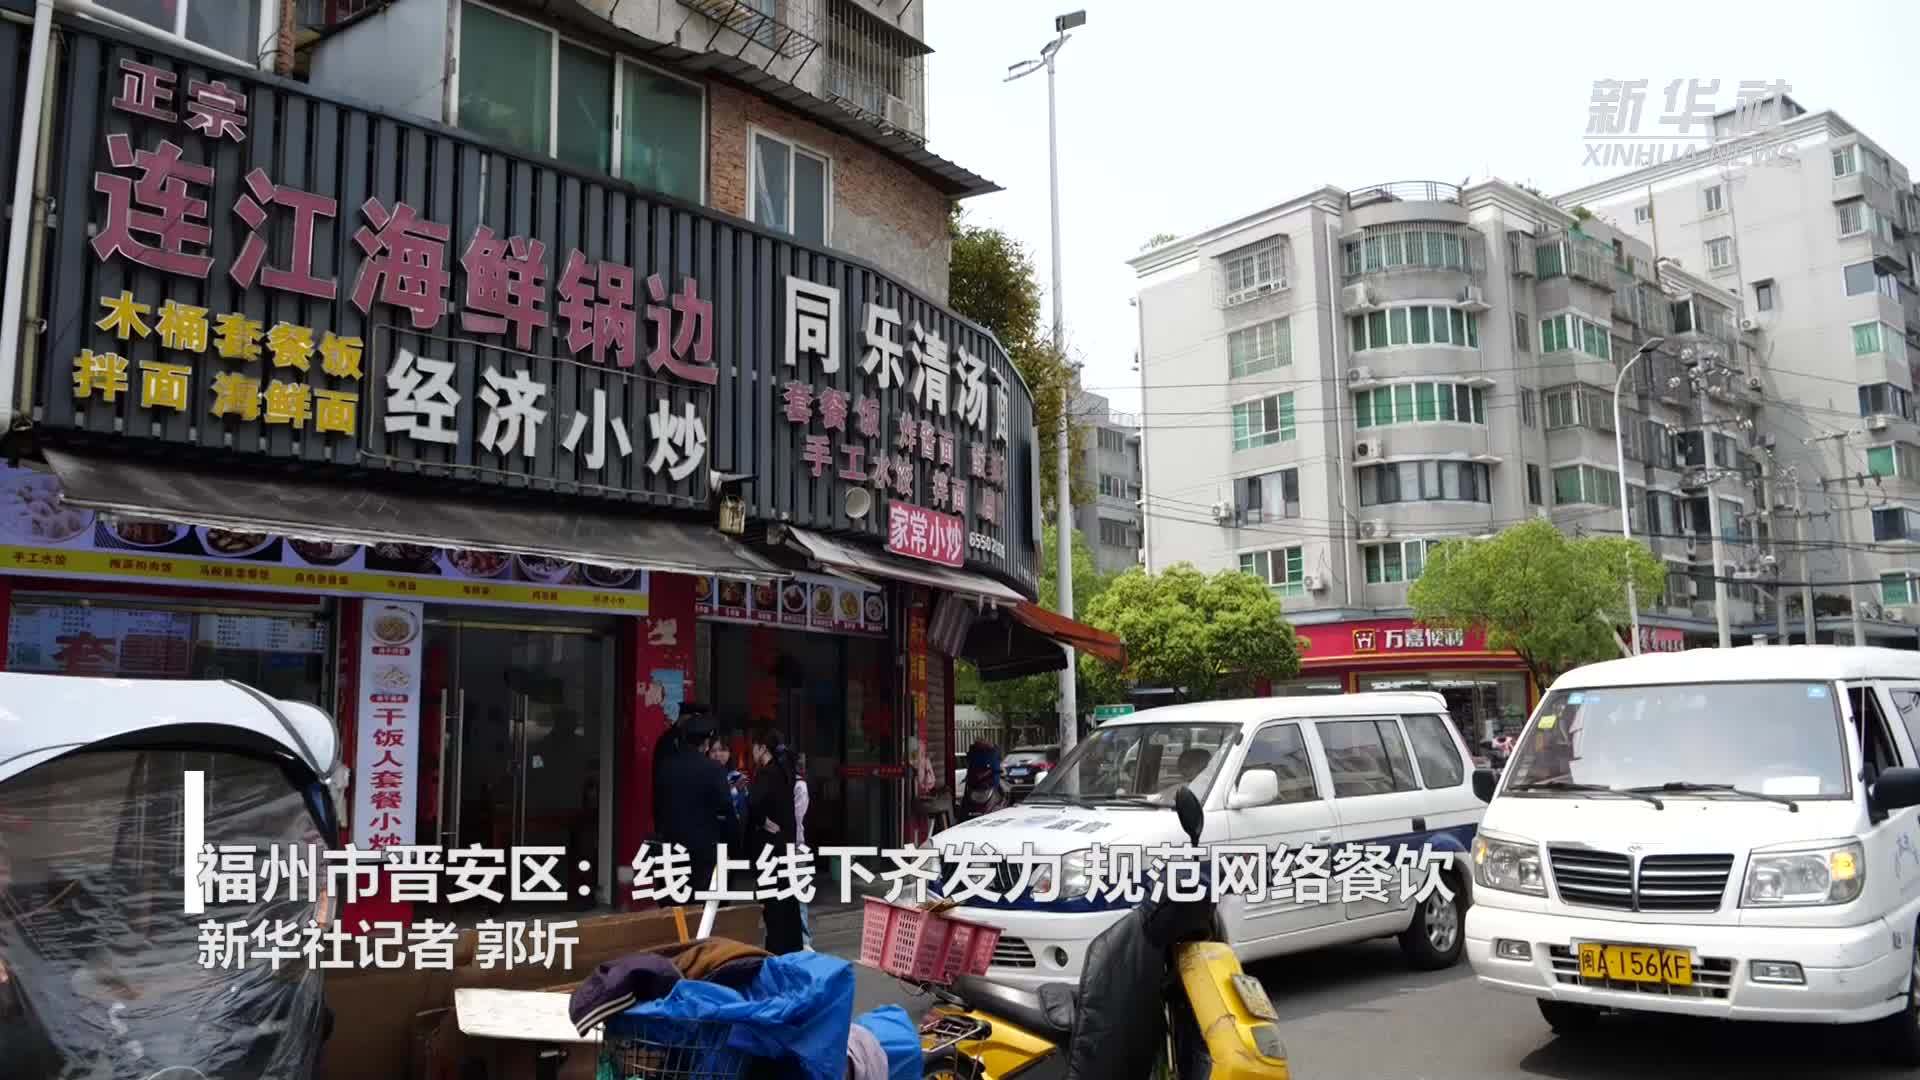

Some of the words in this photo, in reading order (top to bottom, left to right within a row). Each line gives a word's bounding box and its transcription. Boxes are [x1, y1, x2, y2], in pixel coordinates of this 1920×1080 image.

[113, 58, 247, 143] 正宗
[91, 133, 719, 385] 连江海鲜锅边
[97, 289, 364, 381] 木桶套餐饭
[785, 276, 1008, 444] 同乐清汤面
[72, 349, 191, 411] 拌面
[211, 371, 359, 436] 海鲜面
[385, 349, 707, 481] 经济小炒
[785, 381, 880, 436] 套餐饭
[802, 436, 914, 498] 手工水饺
[890, 506, 962, 561] 家常小炒
[1383, 628, 1464, 649] 万嘉便利
[369, 708, 407, 850] 干饭人套餐小炒
